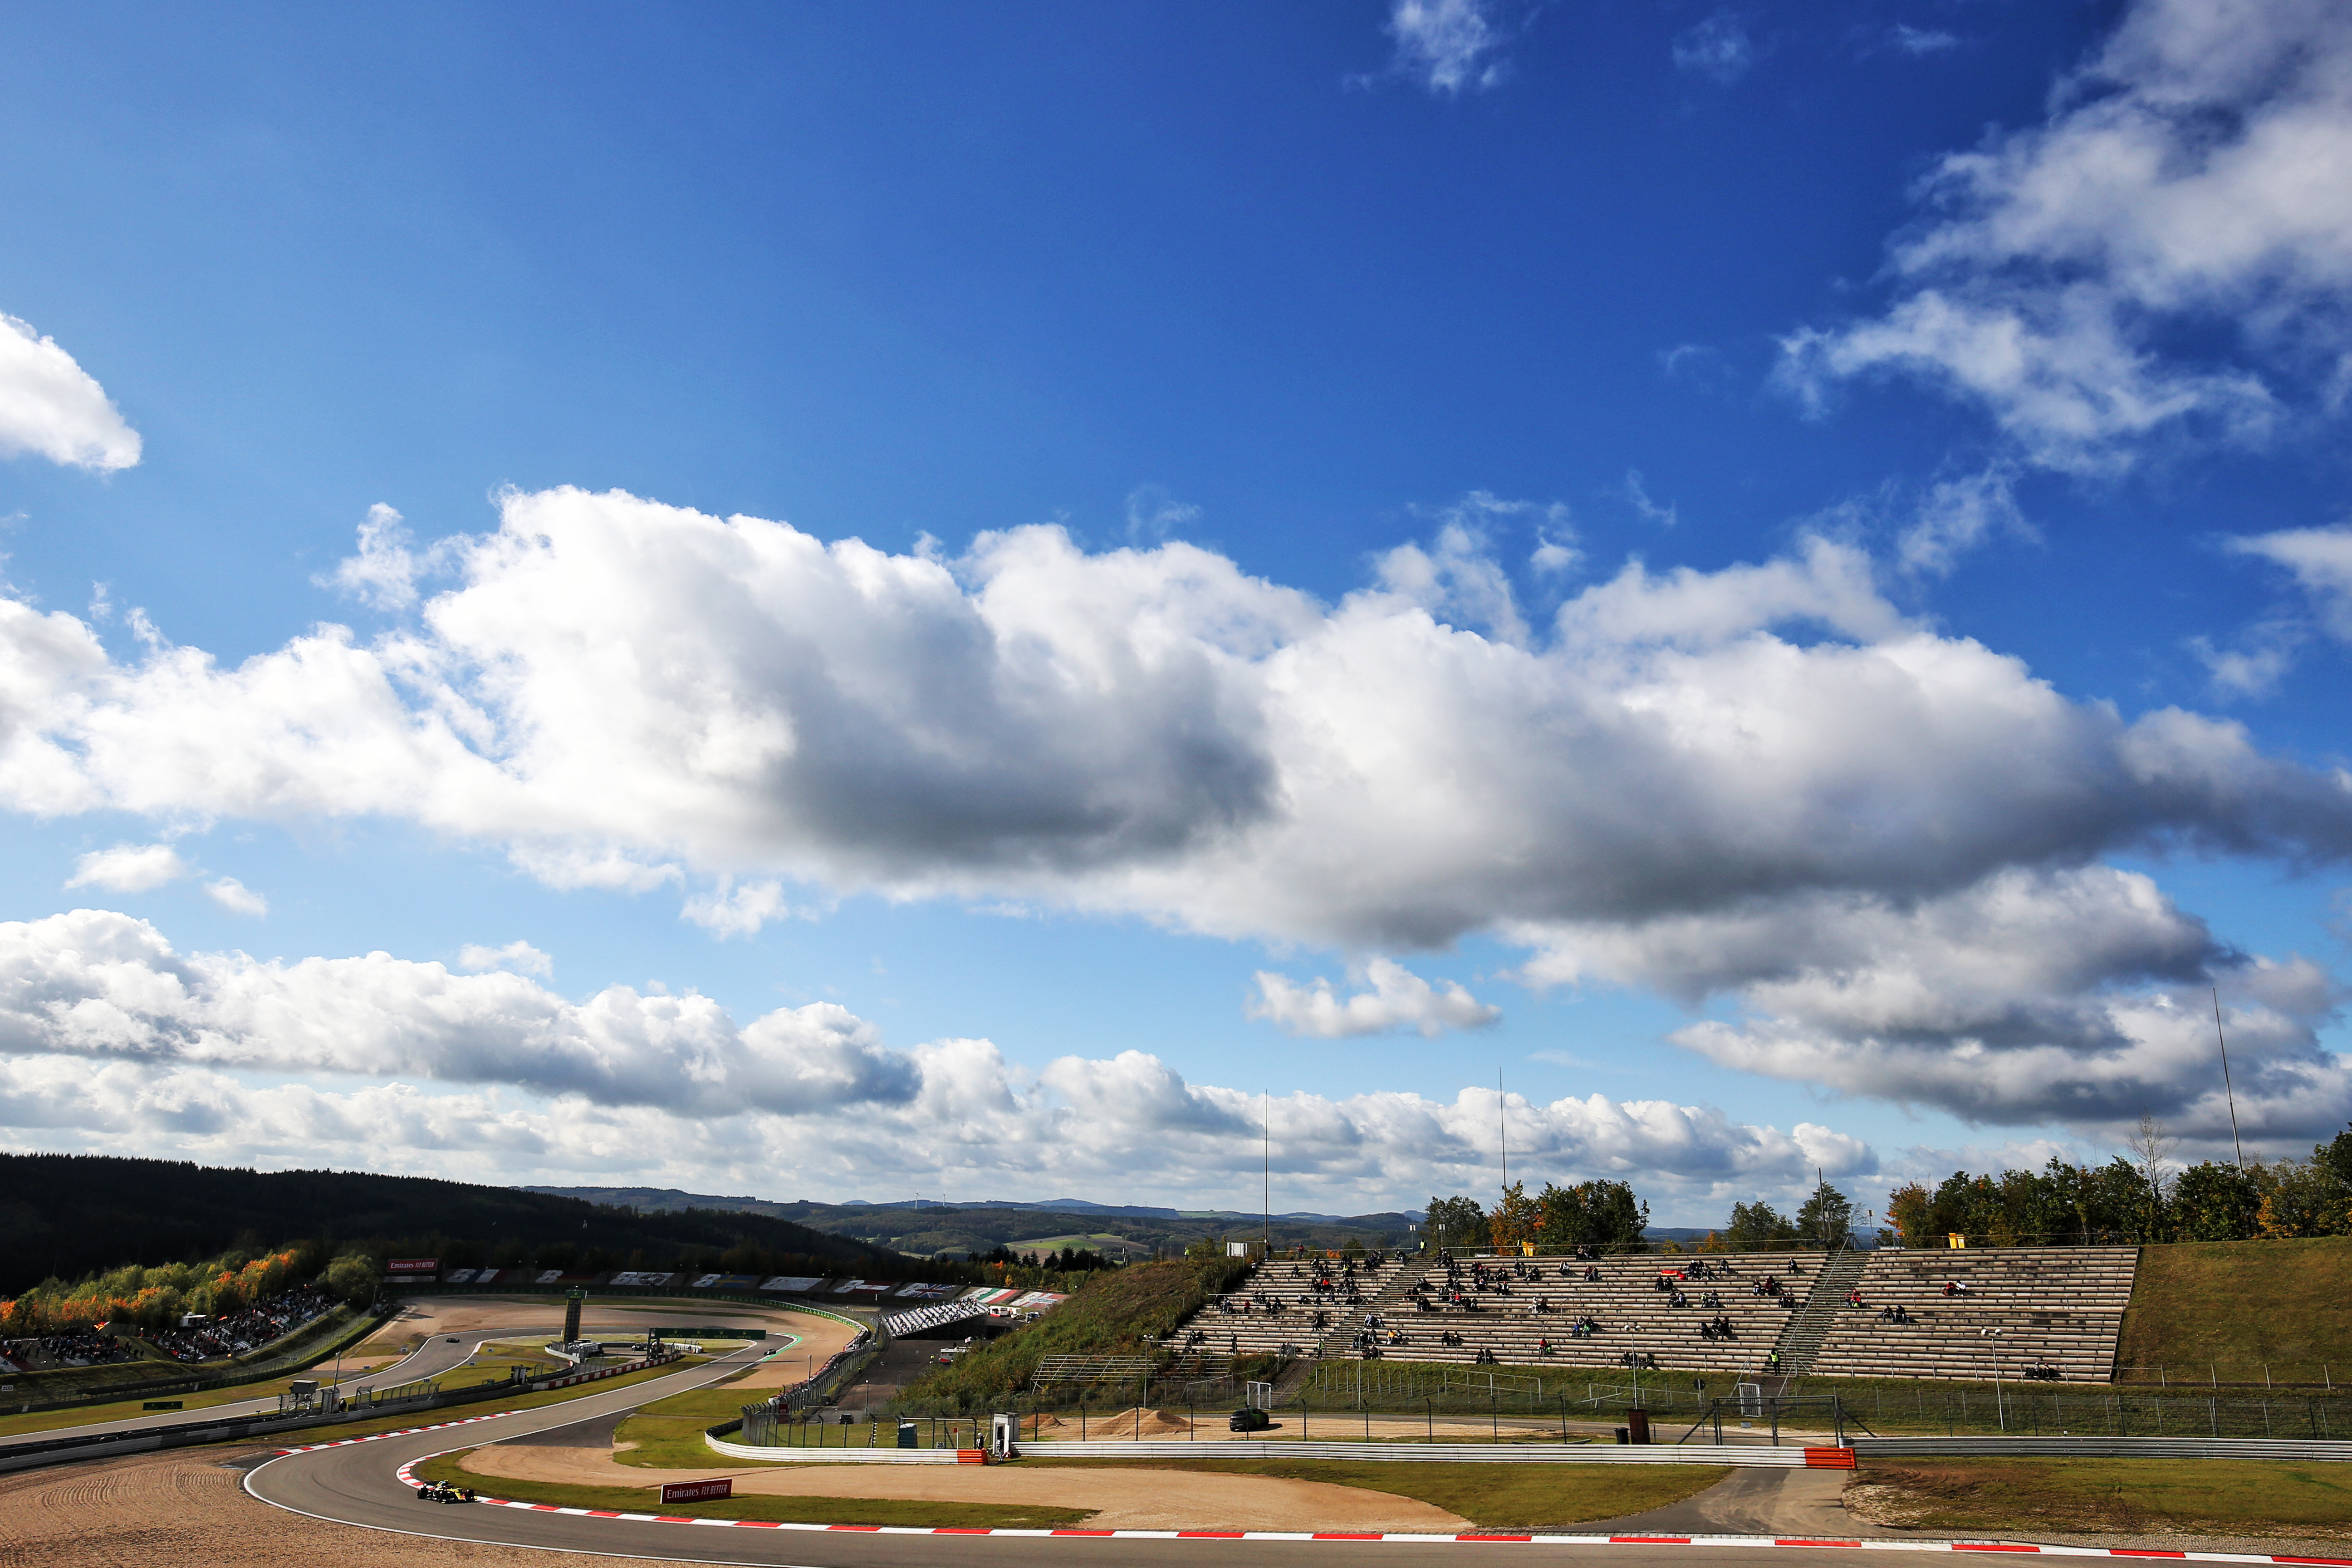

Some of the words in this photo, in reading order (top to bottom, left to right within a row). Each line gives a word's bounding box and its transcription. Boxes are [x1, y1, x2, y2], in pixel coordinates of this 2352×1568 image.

[666, 1488, 699, 1499] Emirates
[701, 1485, 710, 1495] FLY
[710, 1484, 728, 1494] BETTER
